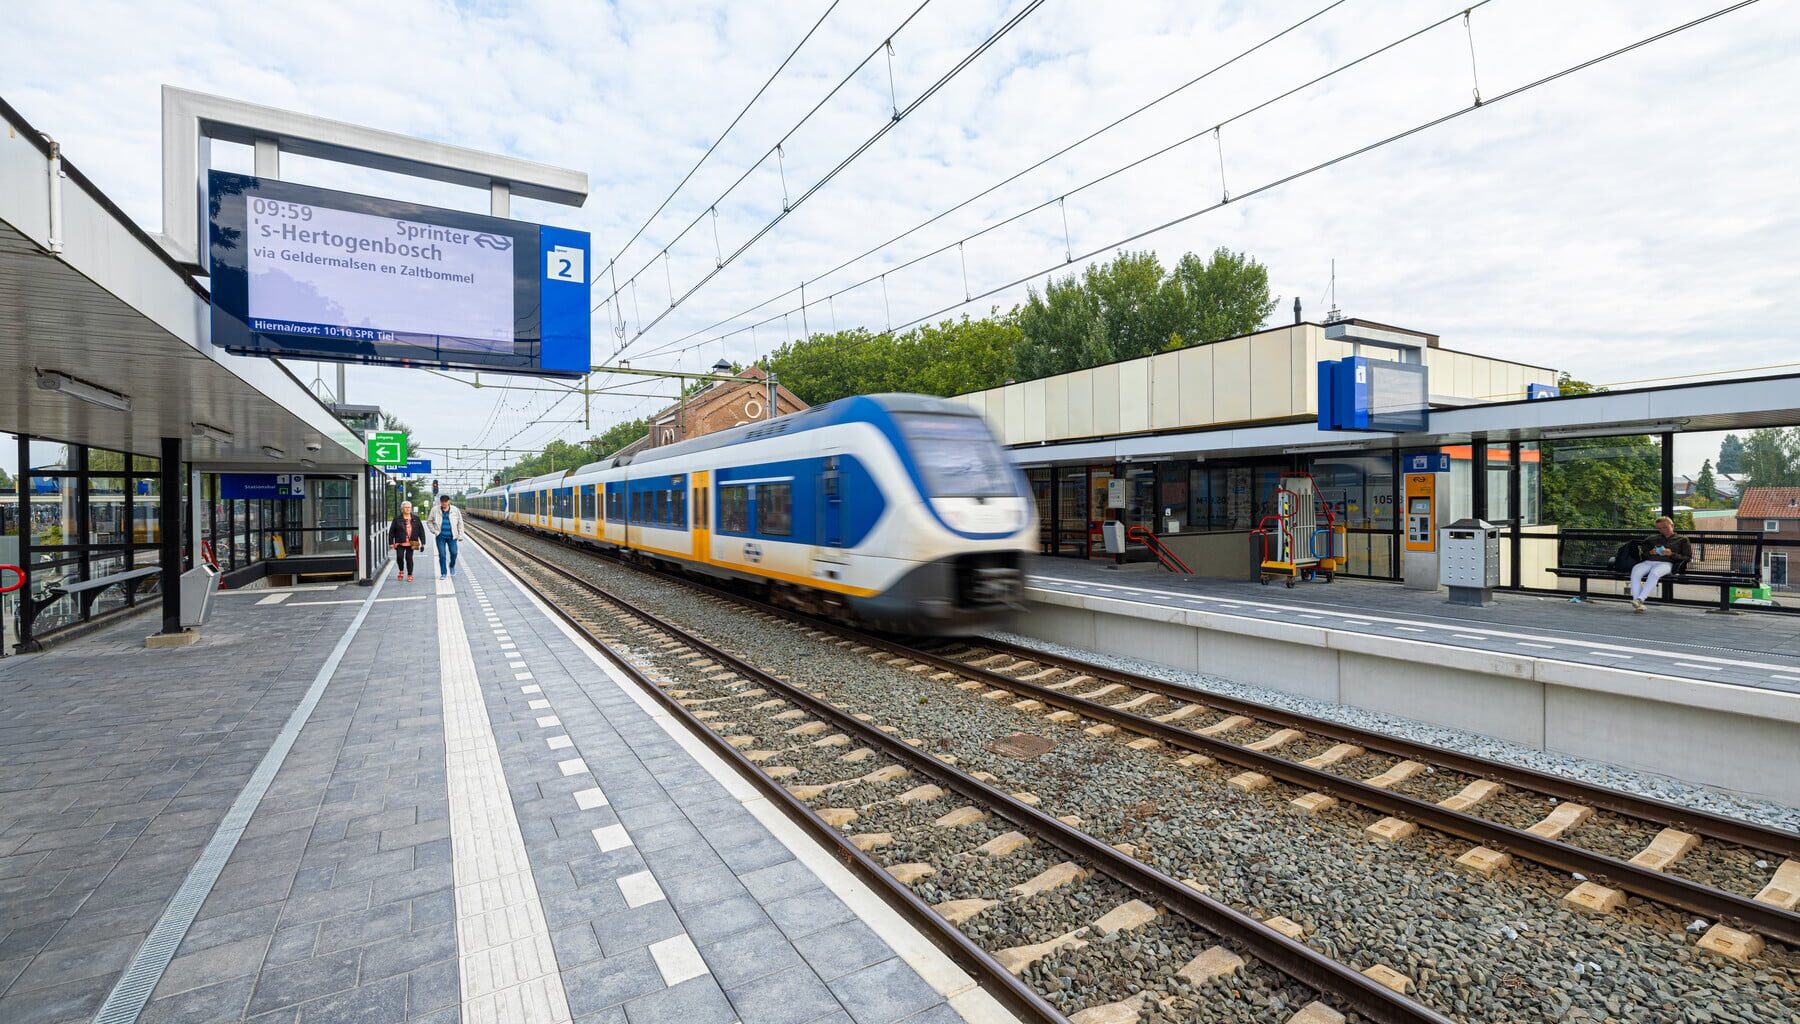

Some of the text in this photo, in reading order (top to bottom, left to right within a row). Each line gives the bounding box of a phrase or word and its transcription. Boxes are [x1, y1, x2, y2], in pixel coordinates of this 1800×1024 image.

[253, 199, 313, 221] 09:59
[254, 218, 442, 261] 's-Hertogenbosch
[396, 220, 470, 245] Sprinter
[253, 246, 474, 284] via Geldermalsen en Zaltbommel
[558, 258, 572, 278] 2
[254, 320, 394, 341] Hierna/next: 10:10 SPR Tiel
